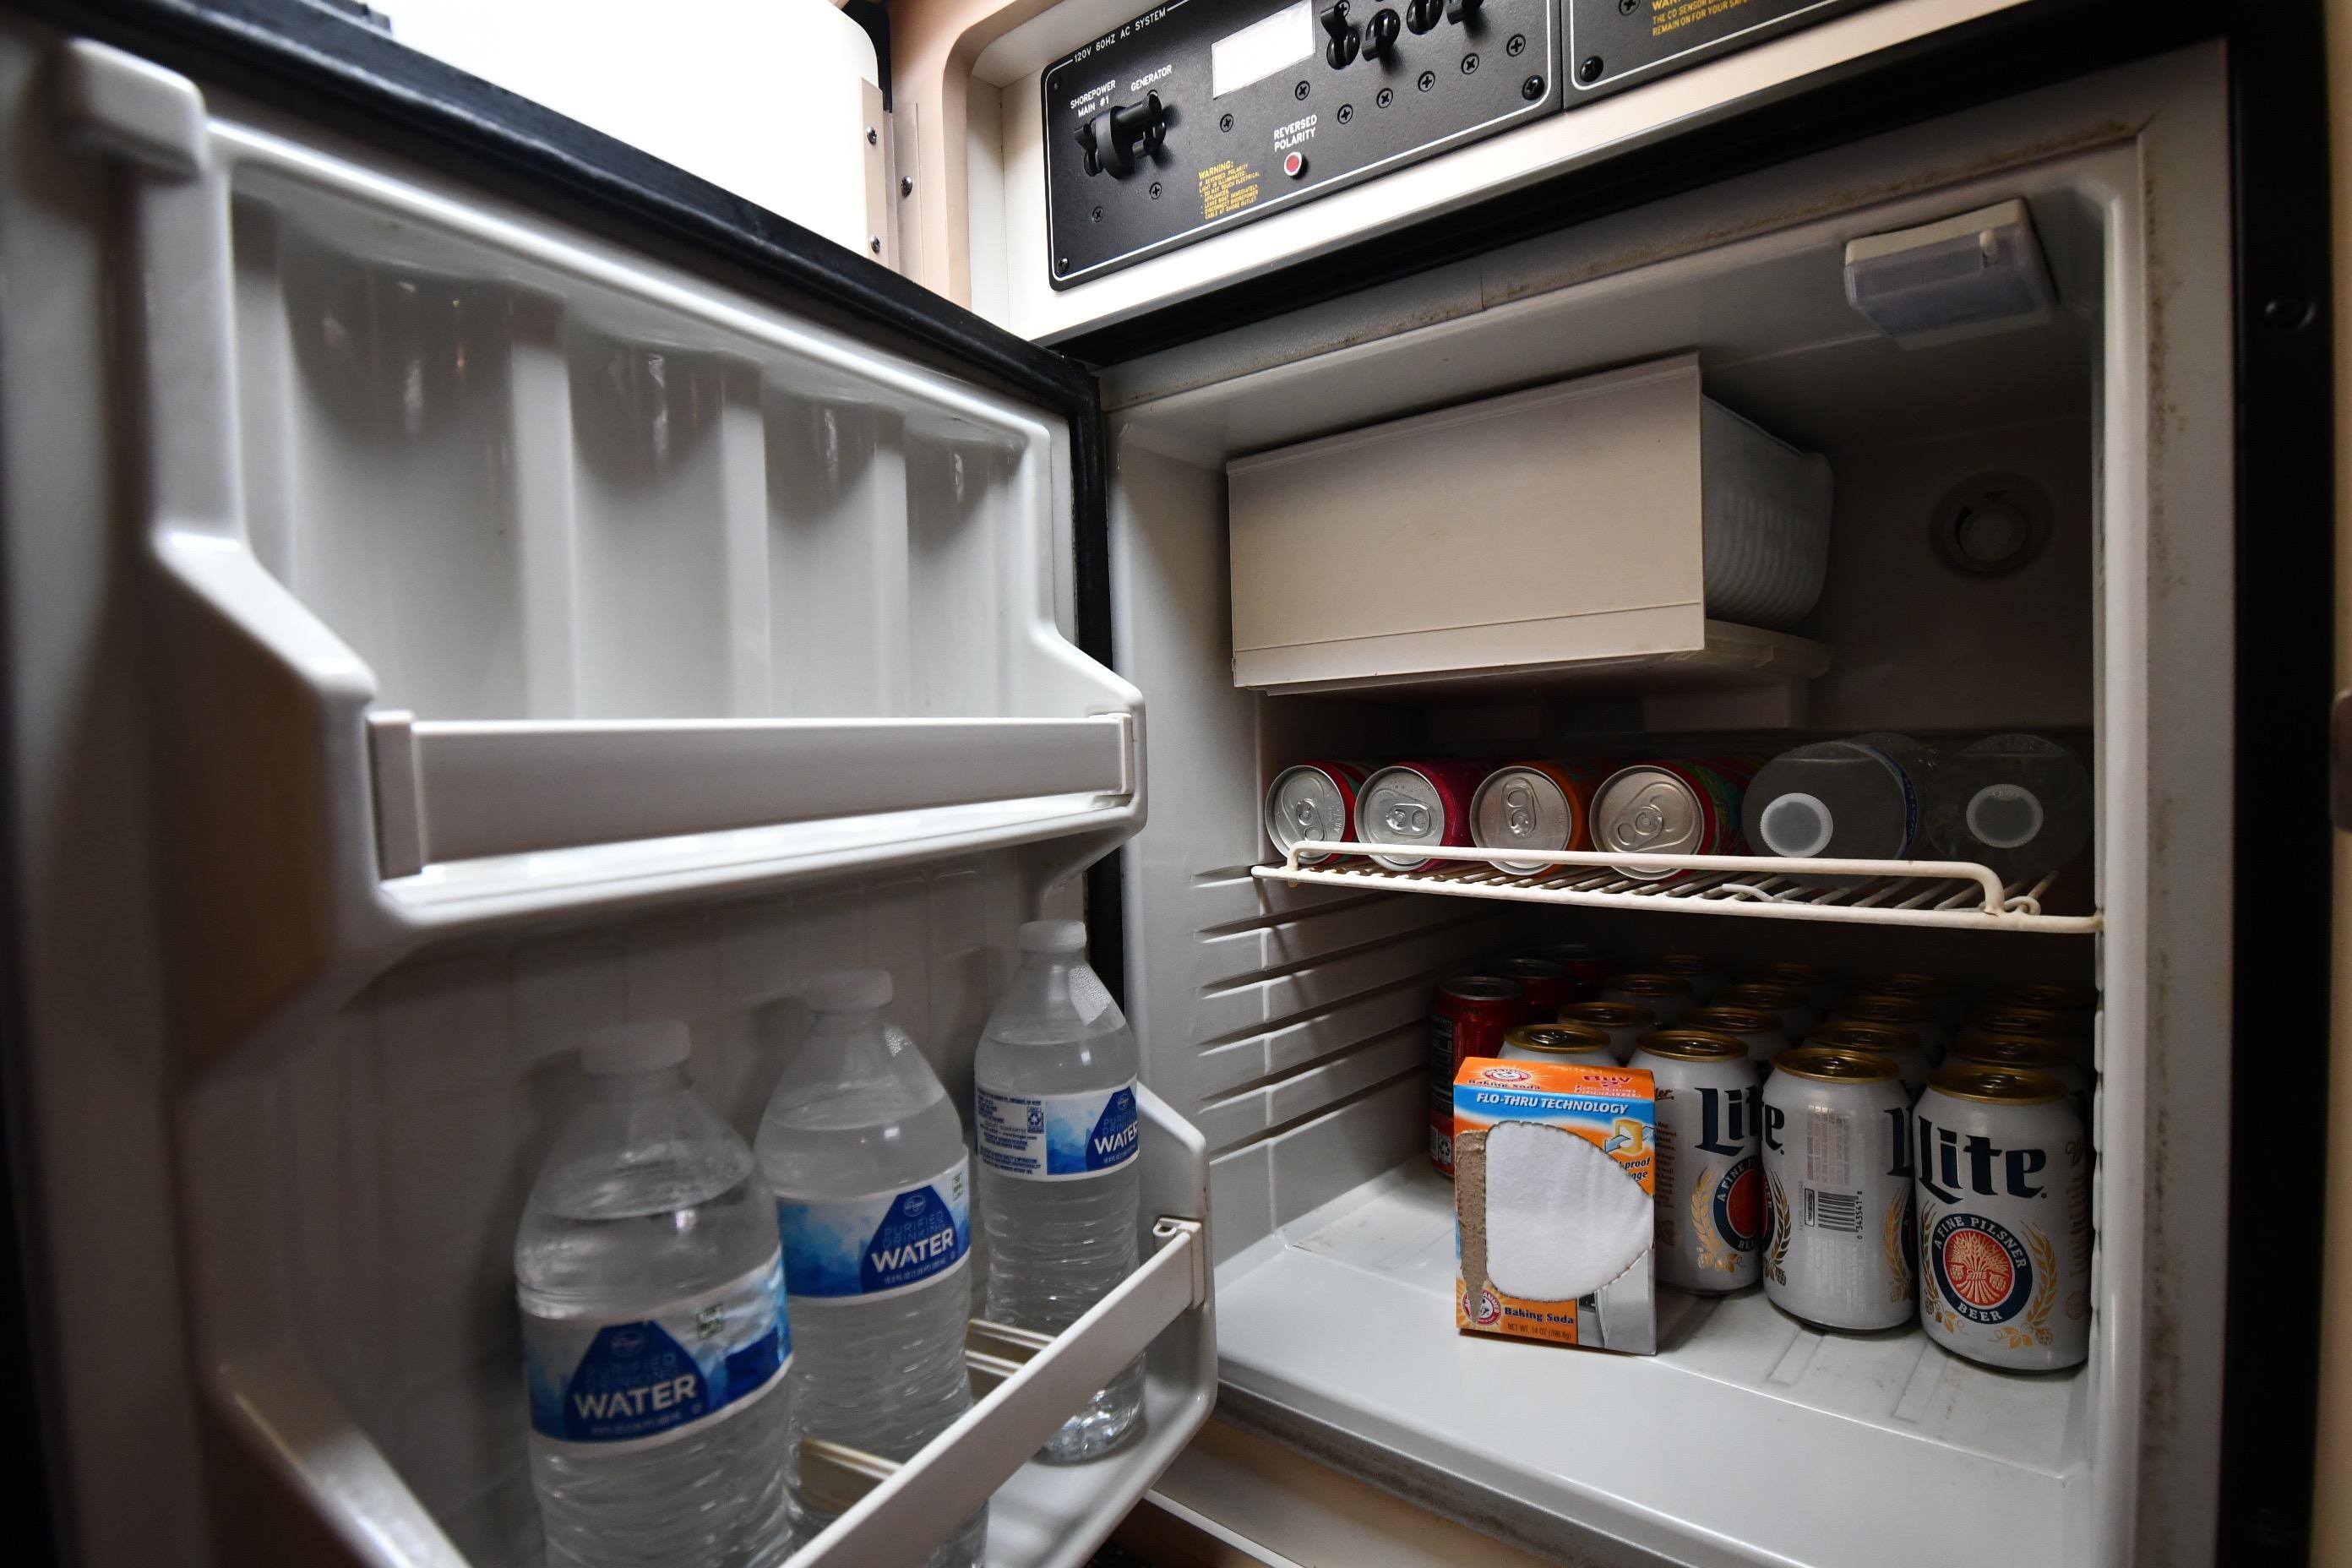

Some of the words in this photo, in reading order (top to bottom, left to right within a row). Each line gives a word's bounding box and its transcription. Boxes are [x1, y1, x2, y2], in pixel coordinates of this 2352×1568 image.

[1652, 19, 1680, 36] REMAIN
[1680, 15, 1691, 26] ON
[1691, 8, 1707, 21] FOR
[1707, 2, 1728, 15] YOUR
[1074, 46, 1092, 63] 120V
[1096, 33, 1116, 52] 60HZ
[1120, 26, 1130, 39] AC
[1135, 7, 1166, 30] SYSTEM
[1130, 64, 1173, 92] GENERATOR
[1070, 79, 1116, 109] SHOREPOWER
[1078, 102, 1096, 118] MAIN
[1100, 95, 1109, 107] #1
[1274, 114, 1318, 140] REVERSED
[1274, 126, 1316, 152] POLARITY
[1198, 160, 1233, 180] WARNING:
[1476, 1092, 1538, 1108] FLO-THRU
[1541, 1097, 1629, 1114] TECHNOLOGY
[1094, 1120, 1139, 1155] WATER
[1919, 1114, 2046, 1205] Lite
[884, 1210, 943, 1236] PURIFIED
[1855, 1200, 1864, 1230] 343541
[1937, 1217, 1965, 1239] FINE
[871, 1227, 954, 1273] WATER
[1935, 1239, 1942, 1250] A
[1970, 1217, 2027, 1269] PILSNER
[1505, 1307, 1543, 1322] Baking
[1546, 1313, 1575, 1325] Soda
[1957, 1302, 2004, 1321] BEER
[1507, 1323, 1518, 1331] NET
[572, 1373, 698, 1420] WATER
